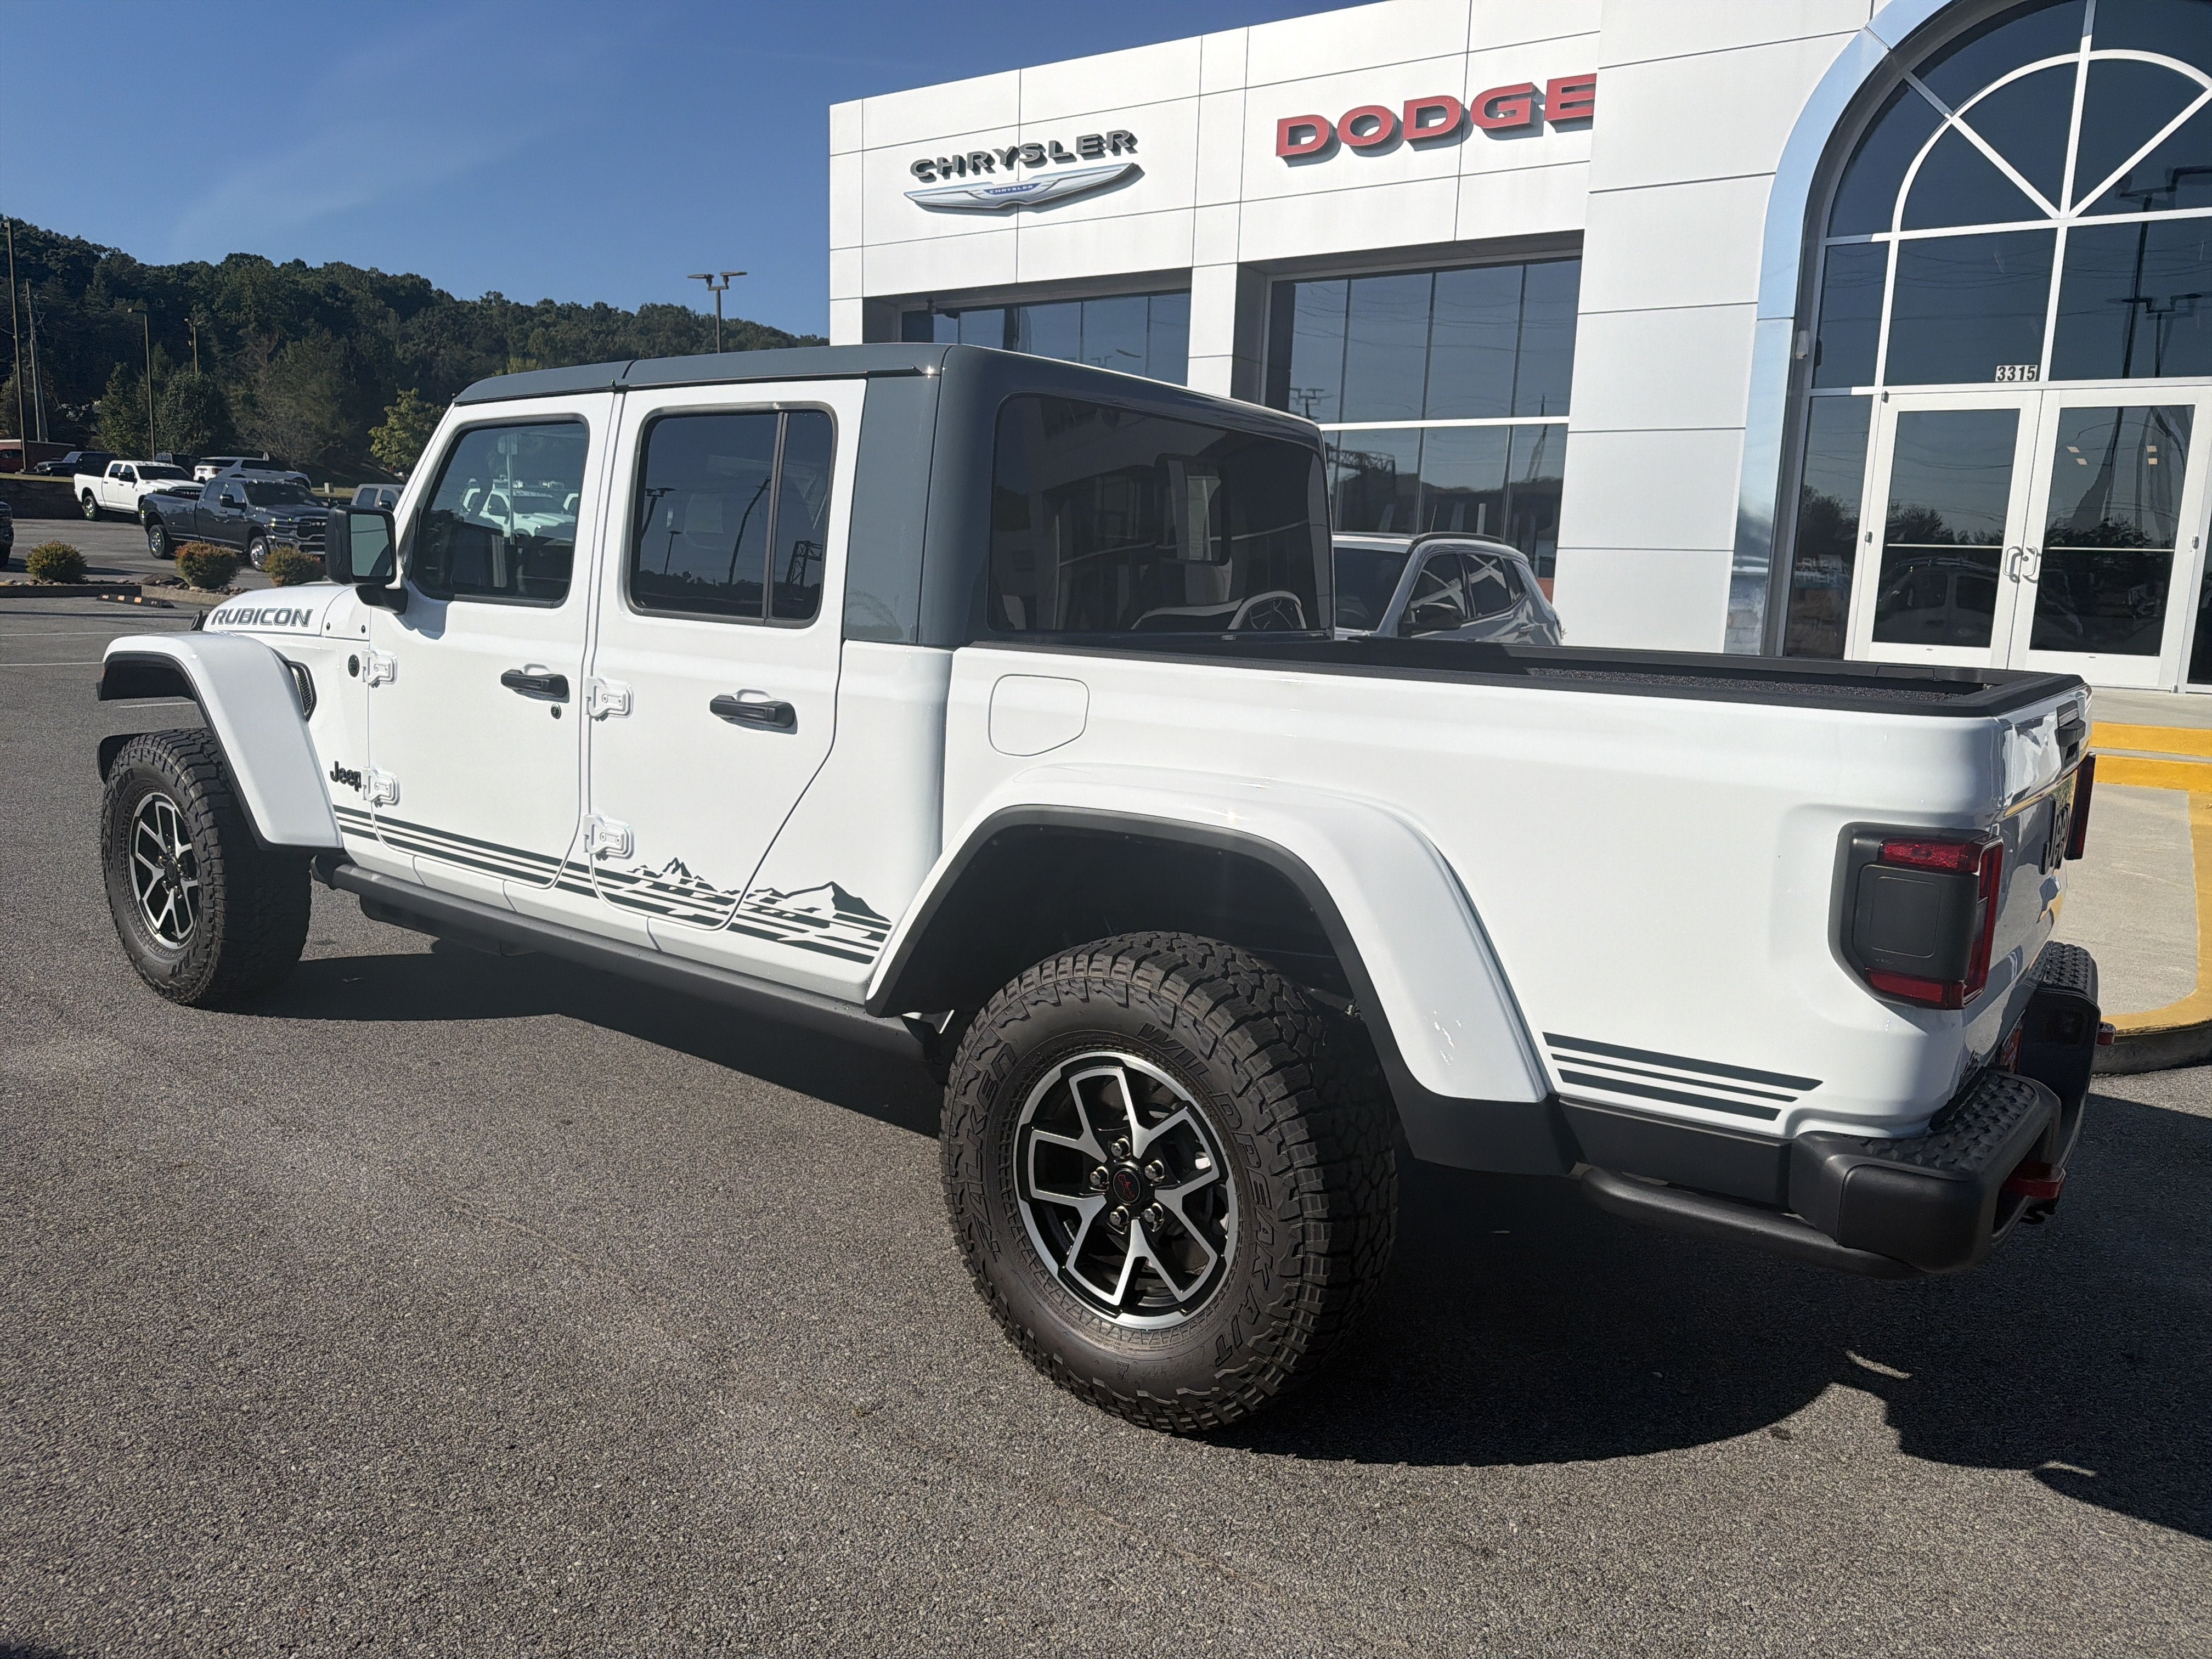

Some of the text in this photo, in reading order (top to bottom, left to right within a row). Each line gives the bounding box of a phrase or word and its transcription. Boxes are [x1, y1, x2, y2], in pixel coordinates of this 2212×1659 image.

[1276, 73, 1597, 157] DODGE
[910, 129, 1135, 180] CHRYSLER
[989, 184, 1034, 194] CHRYSLER
[1997, 365, 2036, 381] 3315
[210, 607, 314, 628] RUBICON
[330, 760, 362, 792] Jeep
